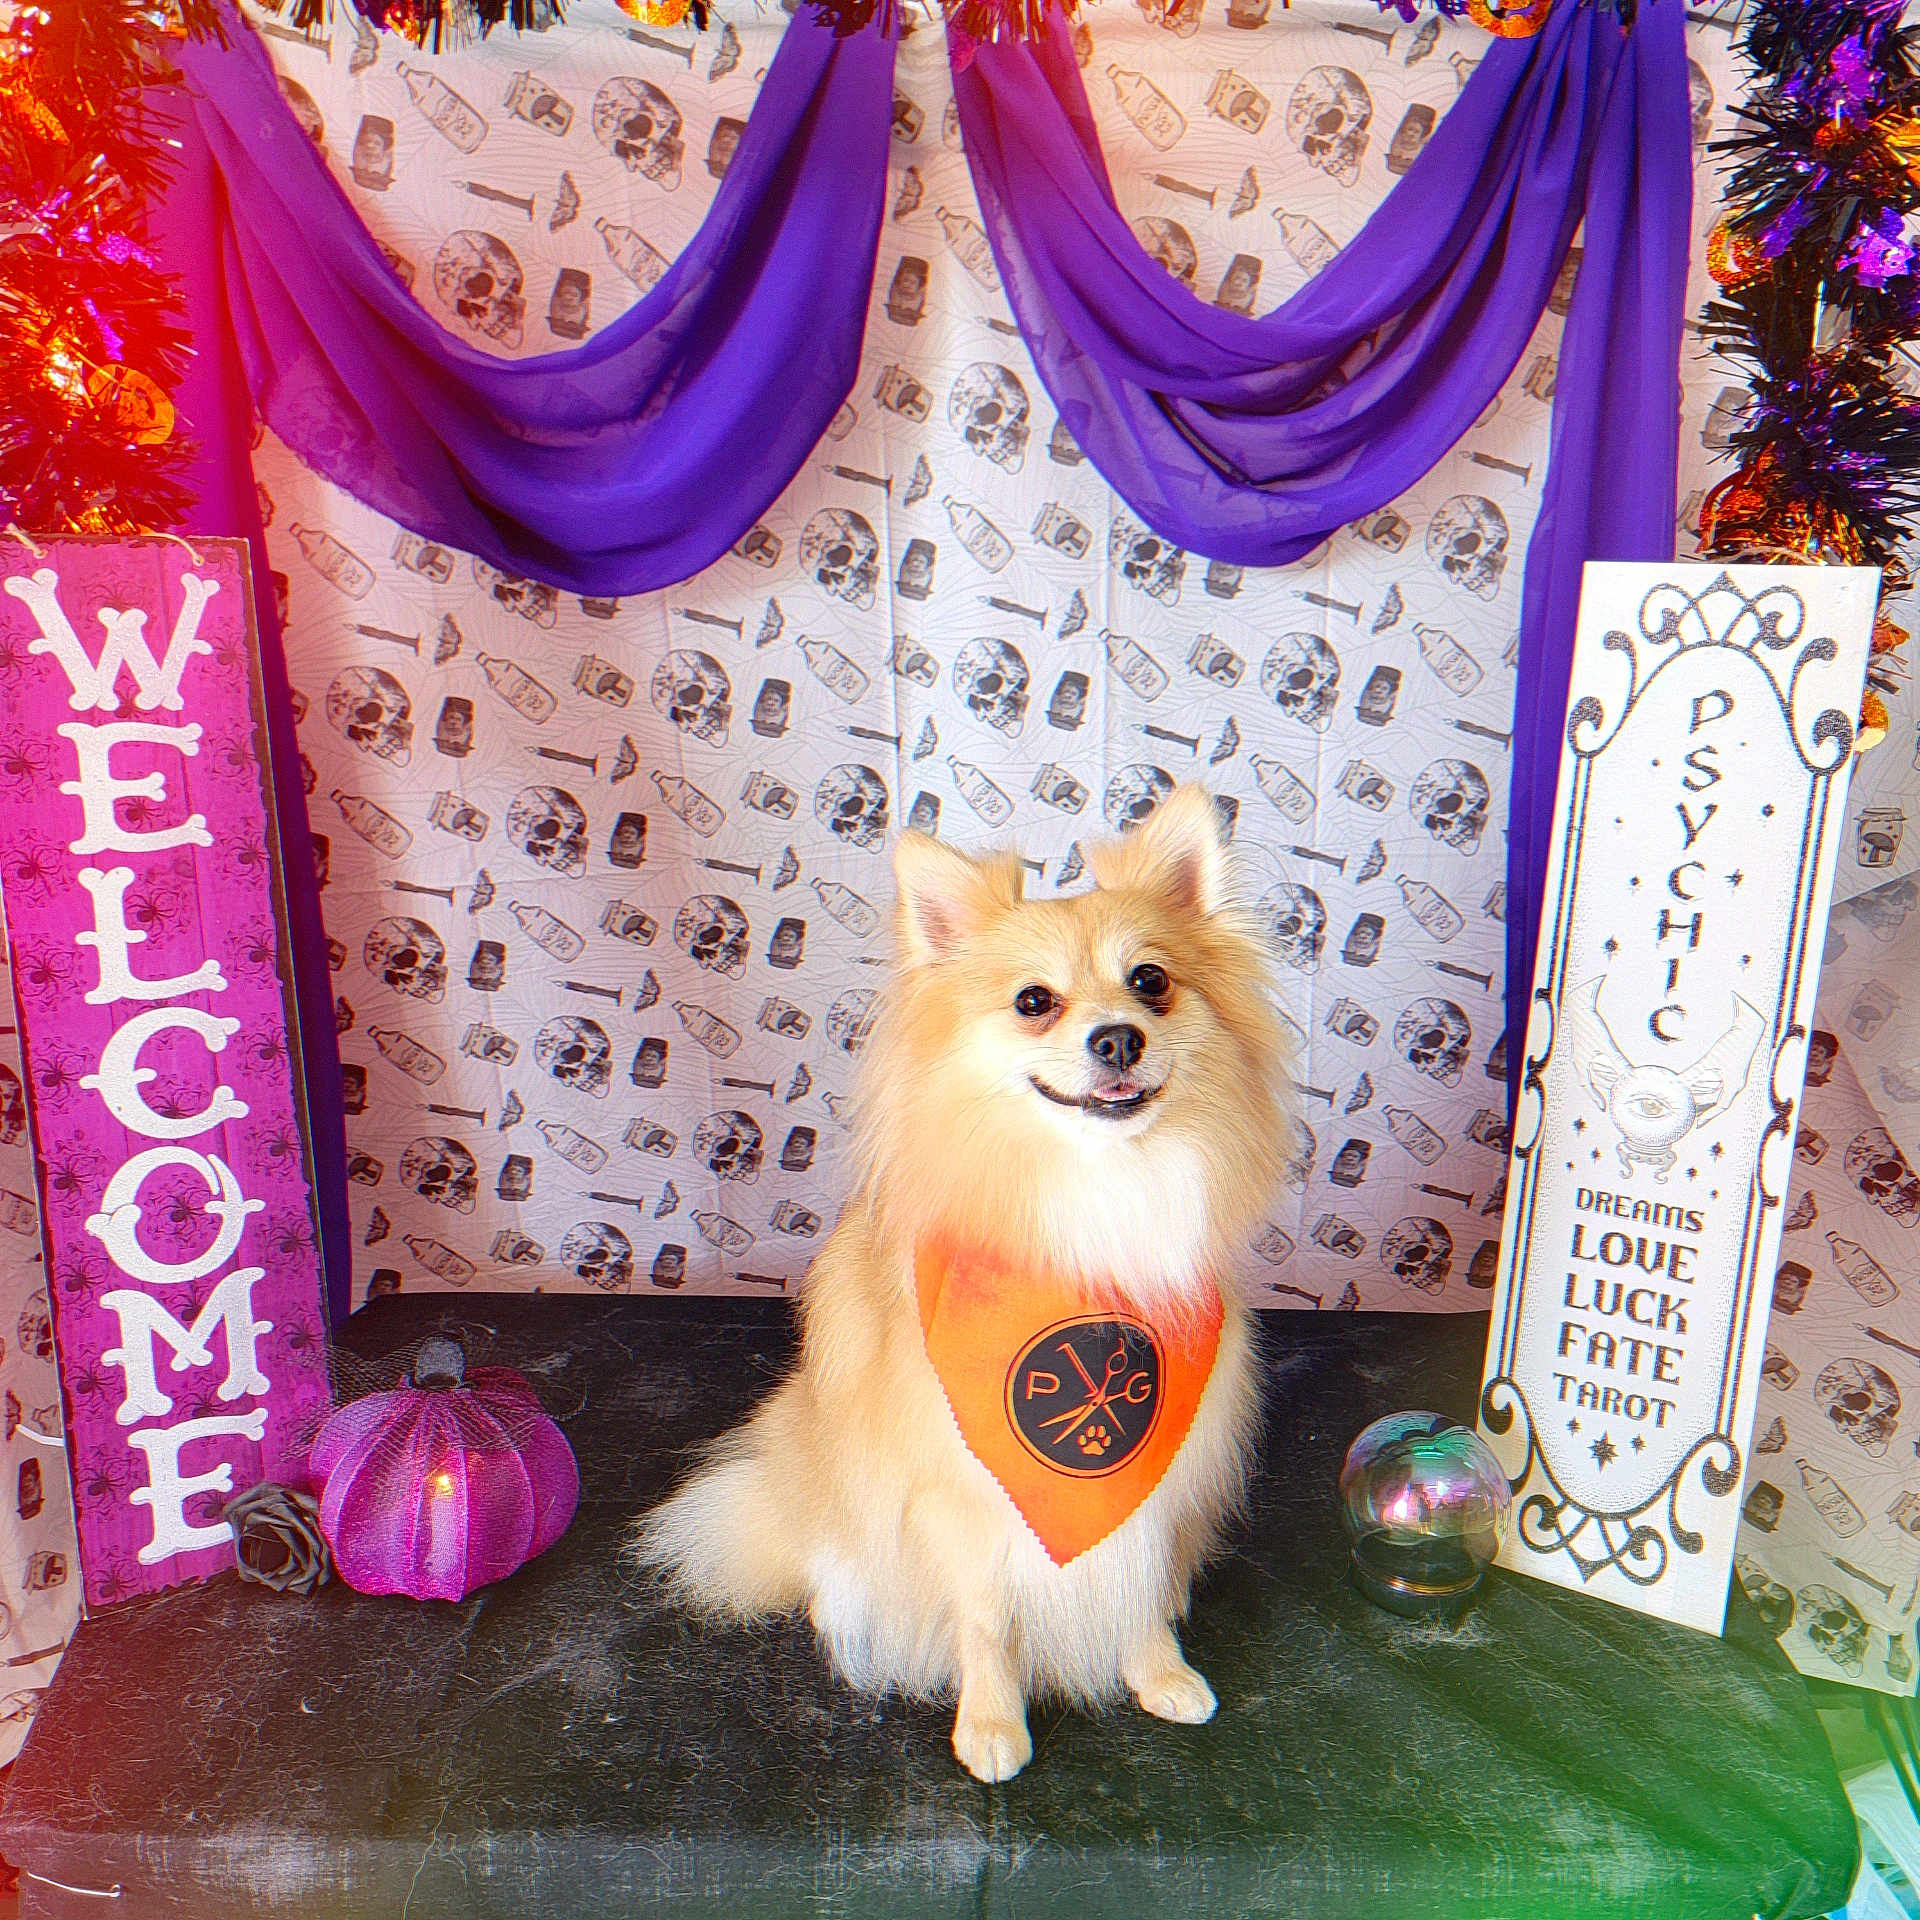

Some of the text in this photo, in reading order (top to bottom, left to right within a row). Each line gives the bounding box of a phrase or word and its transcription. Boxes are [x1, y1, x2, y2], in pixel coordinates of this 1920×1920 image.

[1647, 689, 1735, 1046] PSYCHIC
[3, 568, 273, 1565] WELCOME
[1576, 1187, 1705, 1233] DREAMS
[1570, 1223, 1698, 1284] LOVE
[1563, 1272, 1691, 1335] LUCK
[1557, 1320, 1685, 1385] FATE
[1025, 1370, 1061, 1400] P
[1552, 1372, 1677, 1428] TAROT
